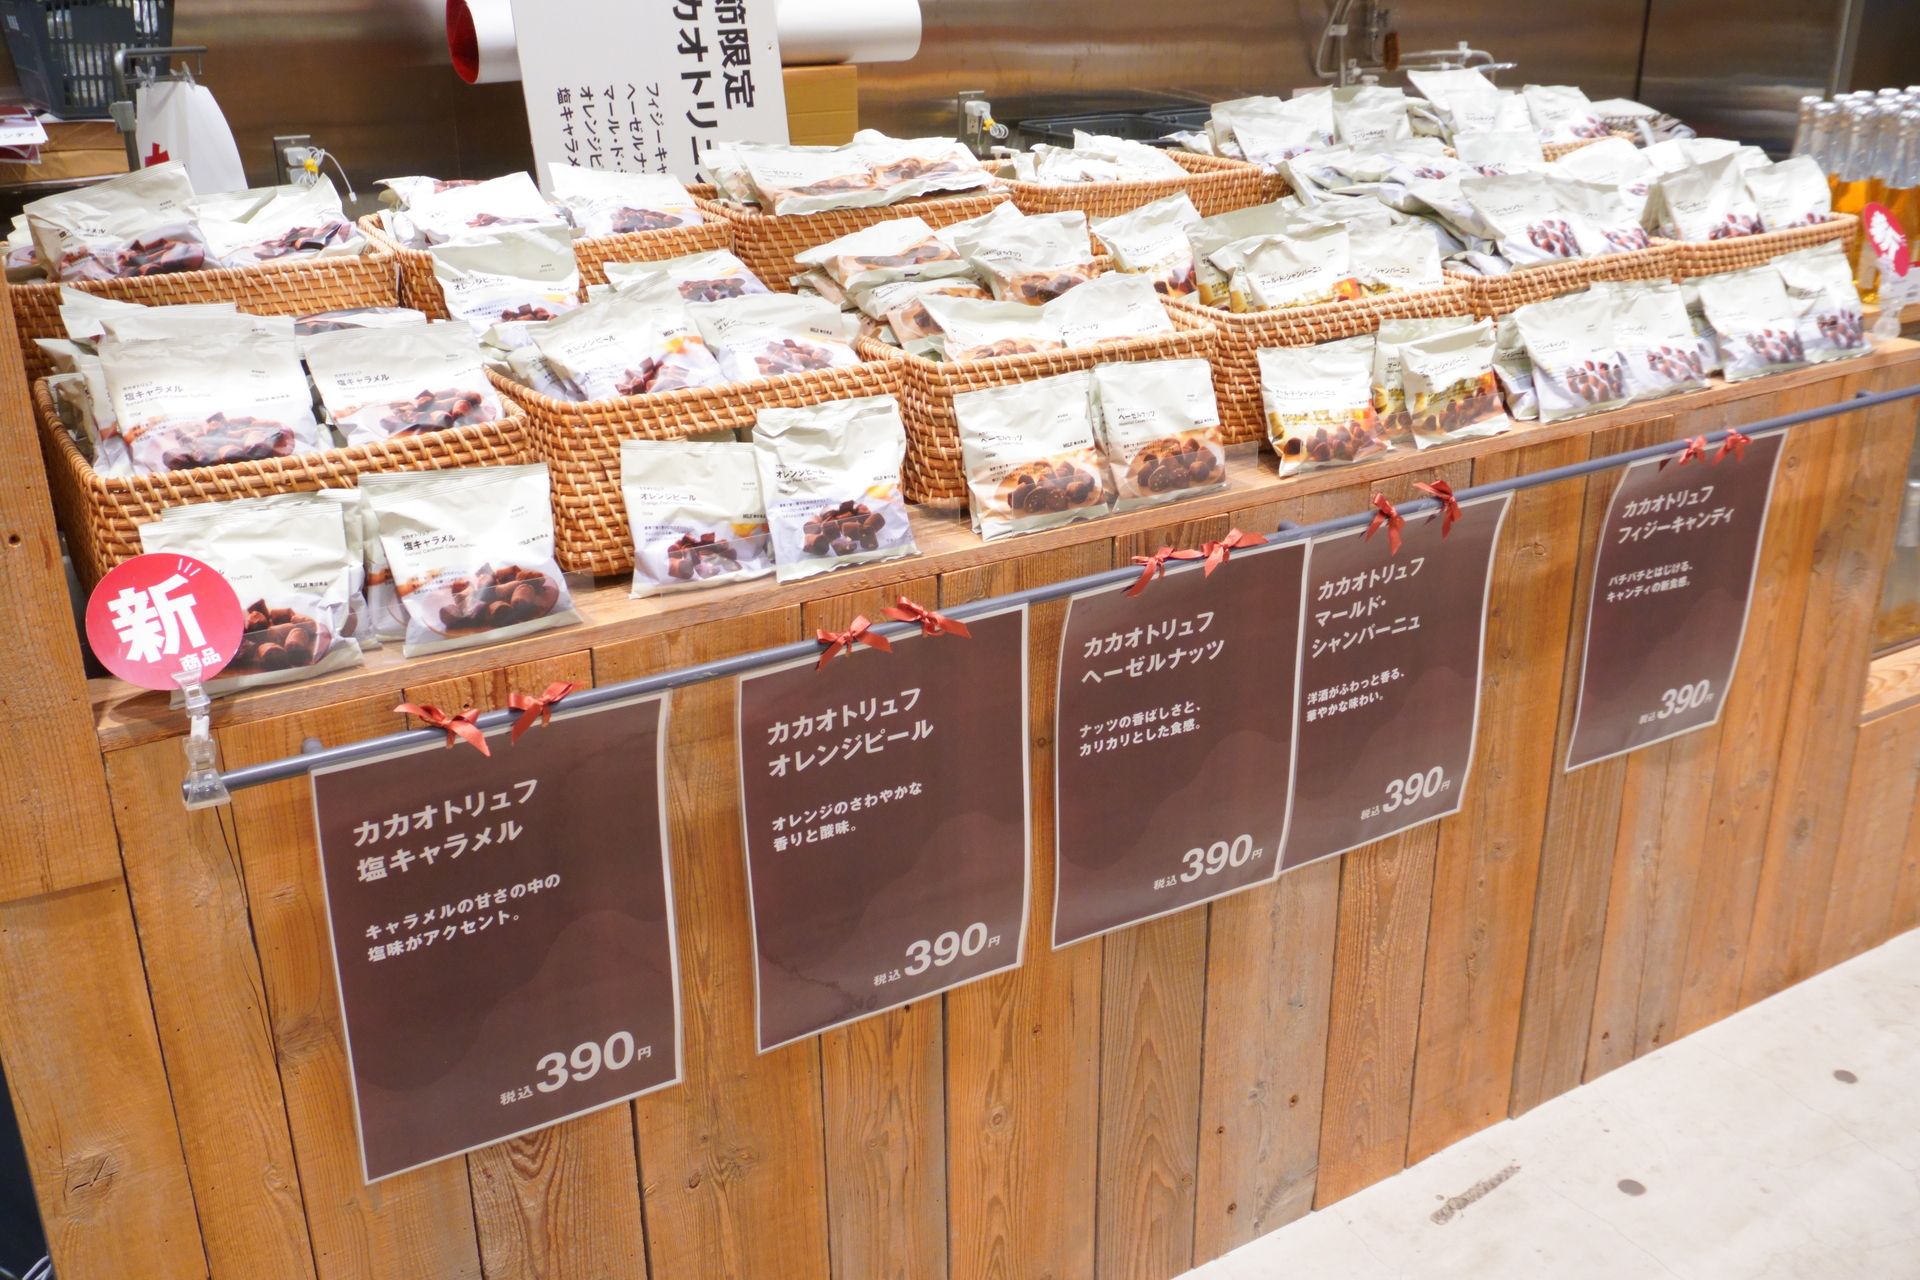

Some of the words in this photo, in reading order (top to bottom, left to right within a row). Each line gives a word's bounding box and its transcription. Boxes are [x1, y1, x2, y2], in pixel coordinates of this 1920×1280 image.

[124, 385, 184, 402] 塩キャラメル
[336, 373, 390, 387] 塩キャラメル
[640, 492, 697, 502] オレンジピール
[1622, 485, 1715, 519] カカオトリュフ
[403, 534, 456, 551] 塩キャラメル
[1618, 507, 1735, 545] フィジーキャンディ
[1317, 556, 1425, 601] カカオトリュフ
[107, 573, 207, 664] 新
[1083, 610, 1216, 659] カカオトリュフ
[1310, 614, 1421, 659] シャンパーニュ
[1081, 639, 1225, 685] ヘーゼルナッツ
[767, 687, 922, 746] カカオトリュフ
[1079, 701, 1201, 739] ナッツの香ばしさと、
[1306, 692, 1384, 723] 華やかな味わい。
[767, 719, 934, 778] オレンジピール
[1079, 718, 1201, 758] カリカリとした食感。
[353, 778, 539, 847] カカオトリュフ
[772, 781, 922, 832] オレンジのさわやかな
[357, 820, 524, 883] 塩キャラメル
[773, 819, 857, 852] 香りと酸味。
[365, 873, 562, 941] キャラメルの甘さの中の
[367, 913, 520, 963] 塩味がアクセント。
